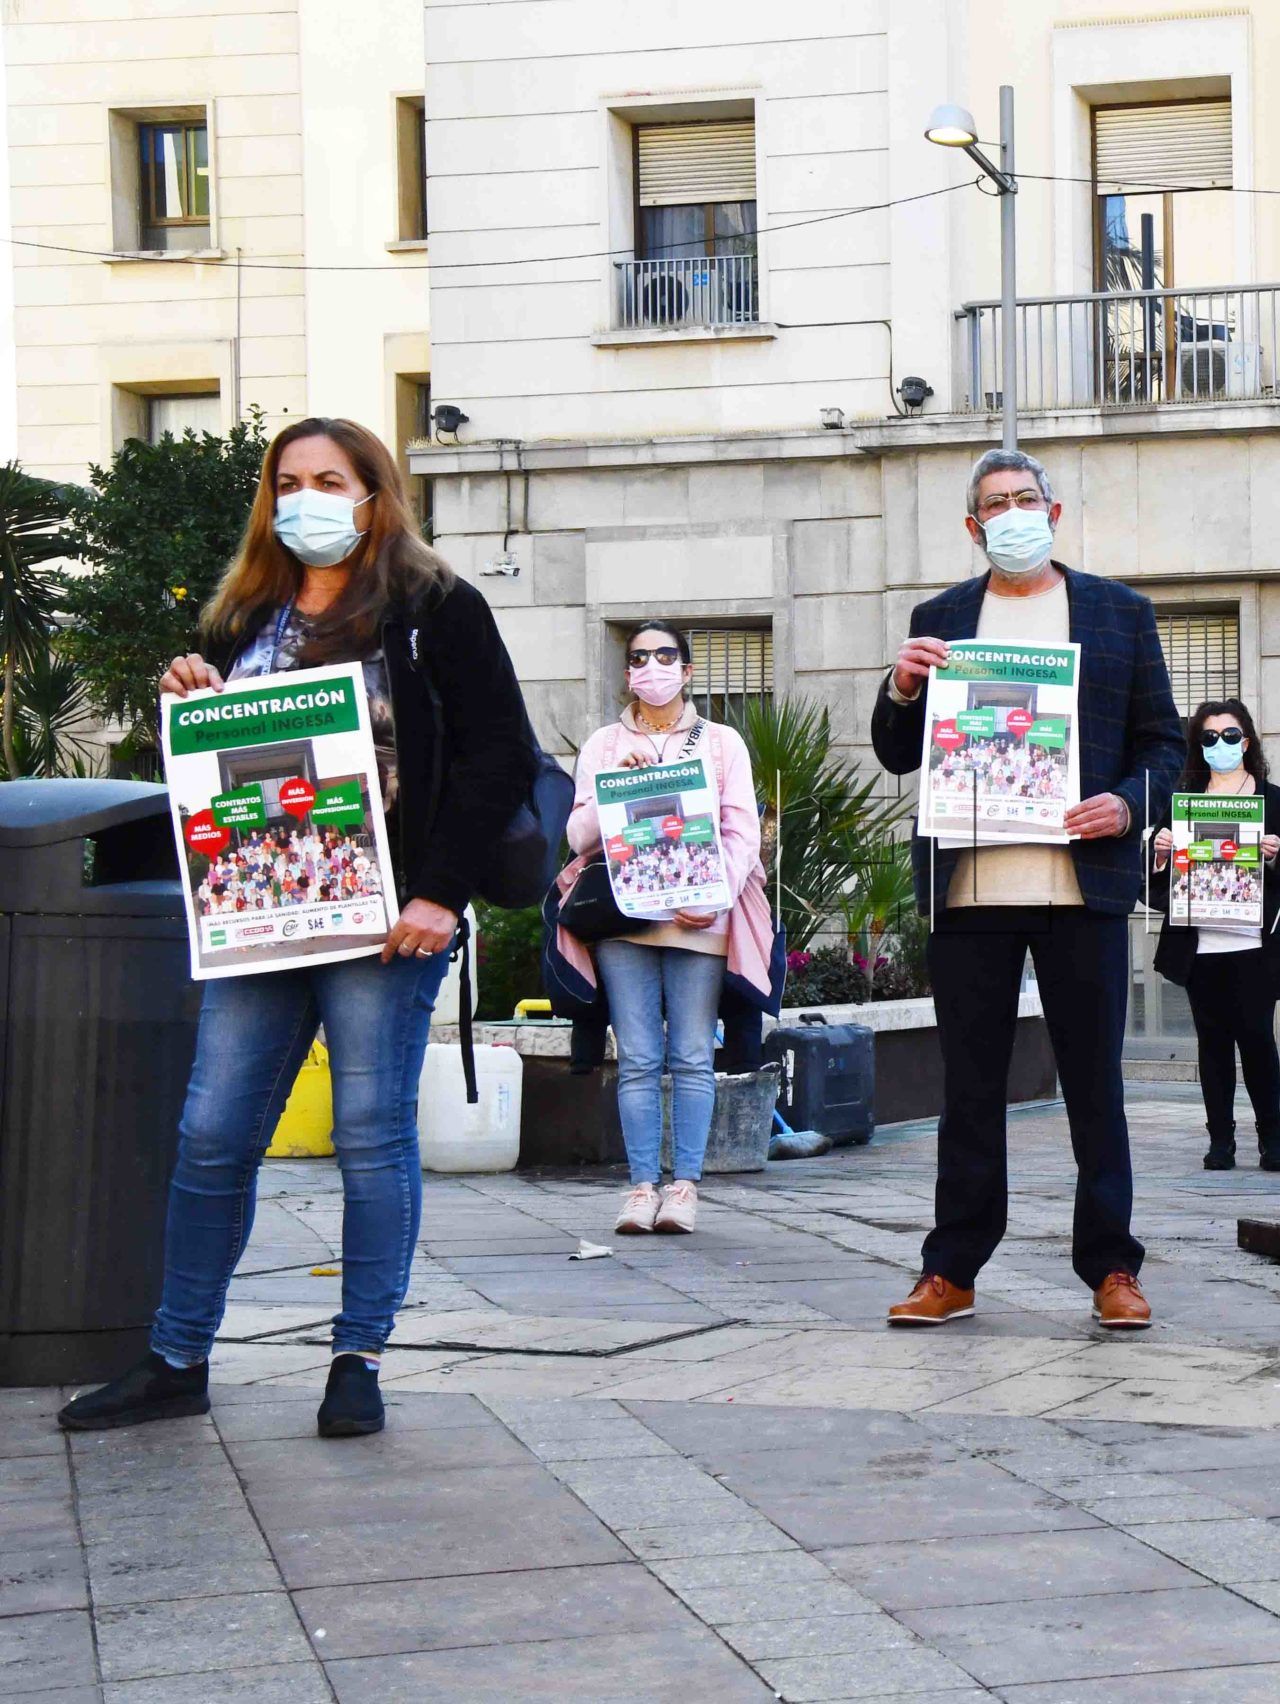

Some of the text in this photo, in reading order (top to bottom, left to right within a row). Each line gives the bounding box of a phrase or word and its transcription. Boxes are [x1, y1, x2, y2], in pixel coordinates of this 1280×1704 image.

[946, 650, 1068, 667] CONCENTRACIÓN
[954, 665, 1058, 680] Personal INGESA
[179, 689, 346, 727] CONCENTRACIÓN
[195, 712, 336, 744] Personal INGESA
[600, 766, 700, 789] CONCENTRACIÓN
[288, 787, 305, 796] MÁS
[610, 778, 694, 798] Personal INGESA
[215, 796, 262, 808] CONTRATOS
[326, 796, 344, 805] MÁS
[1177, 799, 1259, 810] CONCENTRACIÓN
[231, 806, 248, 814] MÁS
[1221, 811, 1252, 819] INGESA
[222, 812, 259, 824] ESTABLES
[194, 824, 211, 833] MÁS
[190, 831, 222, 841] MEDIOS
